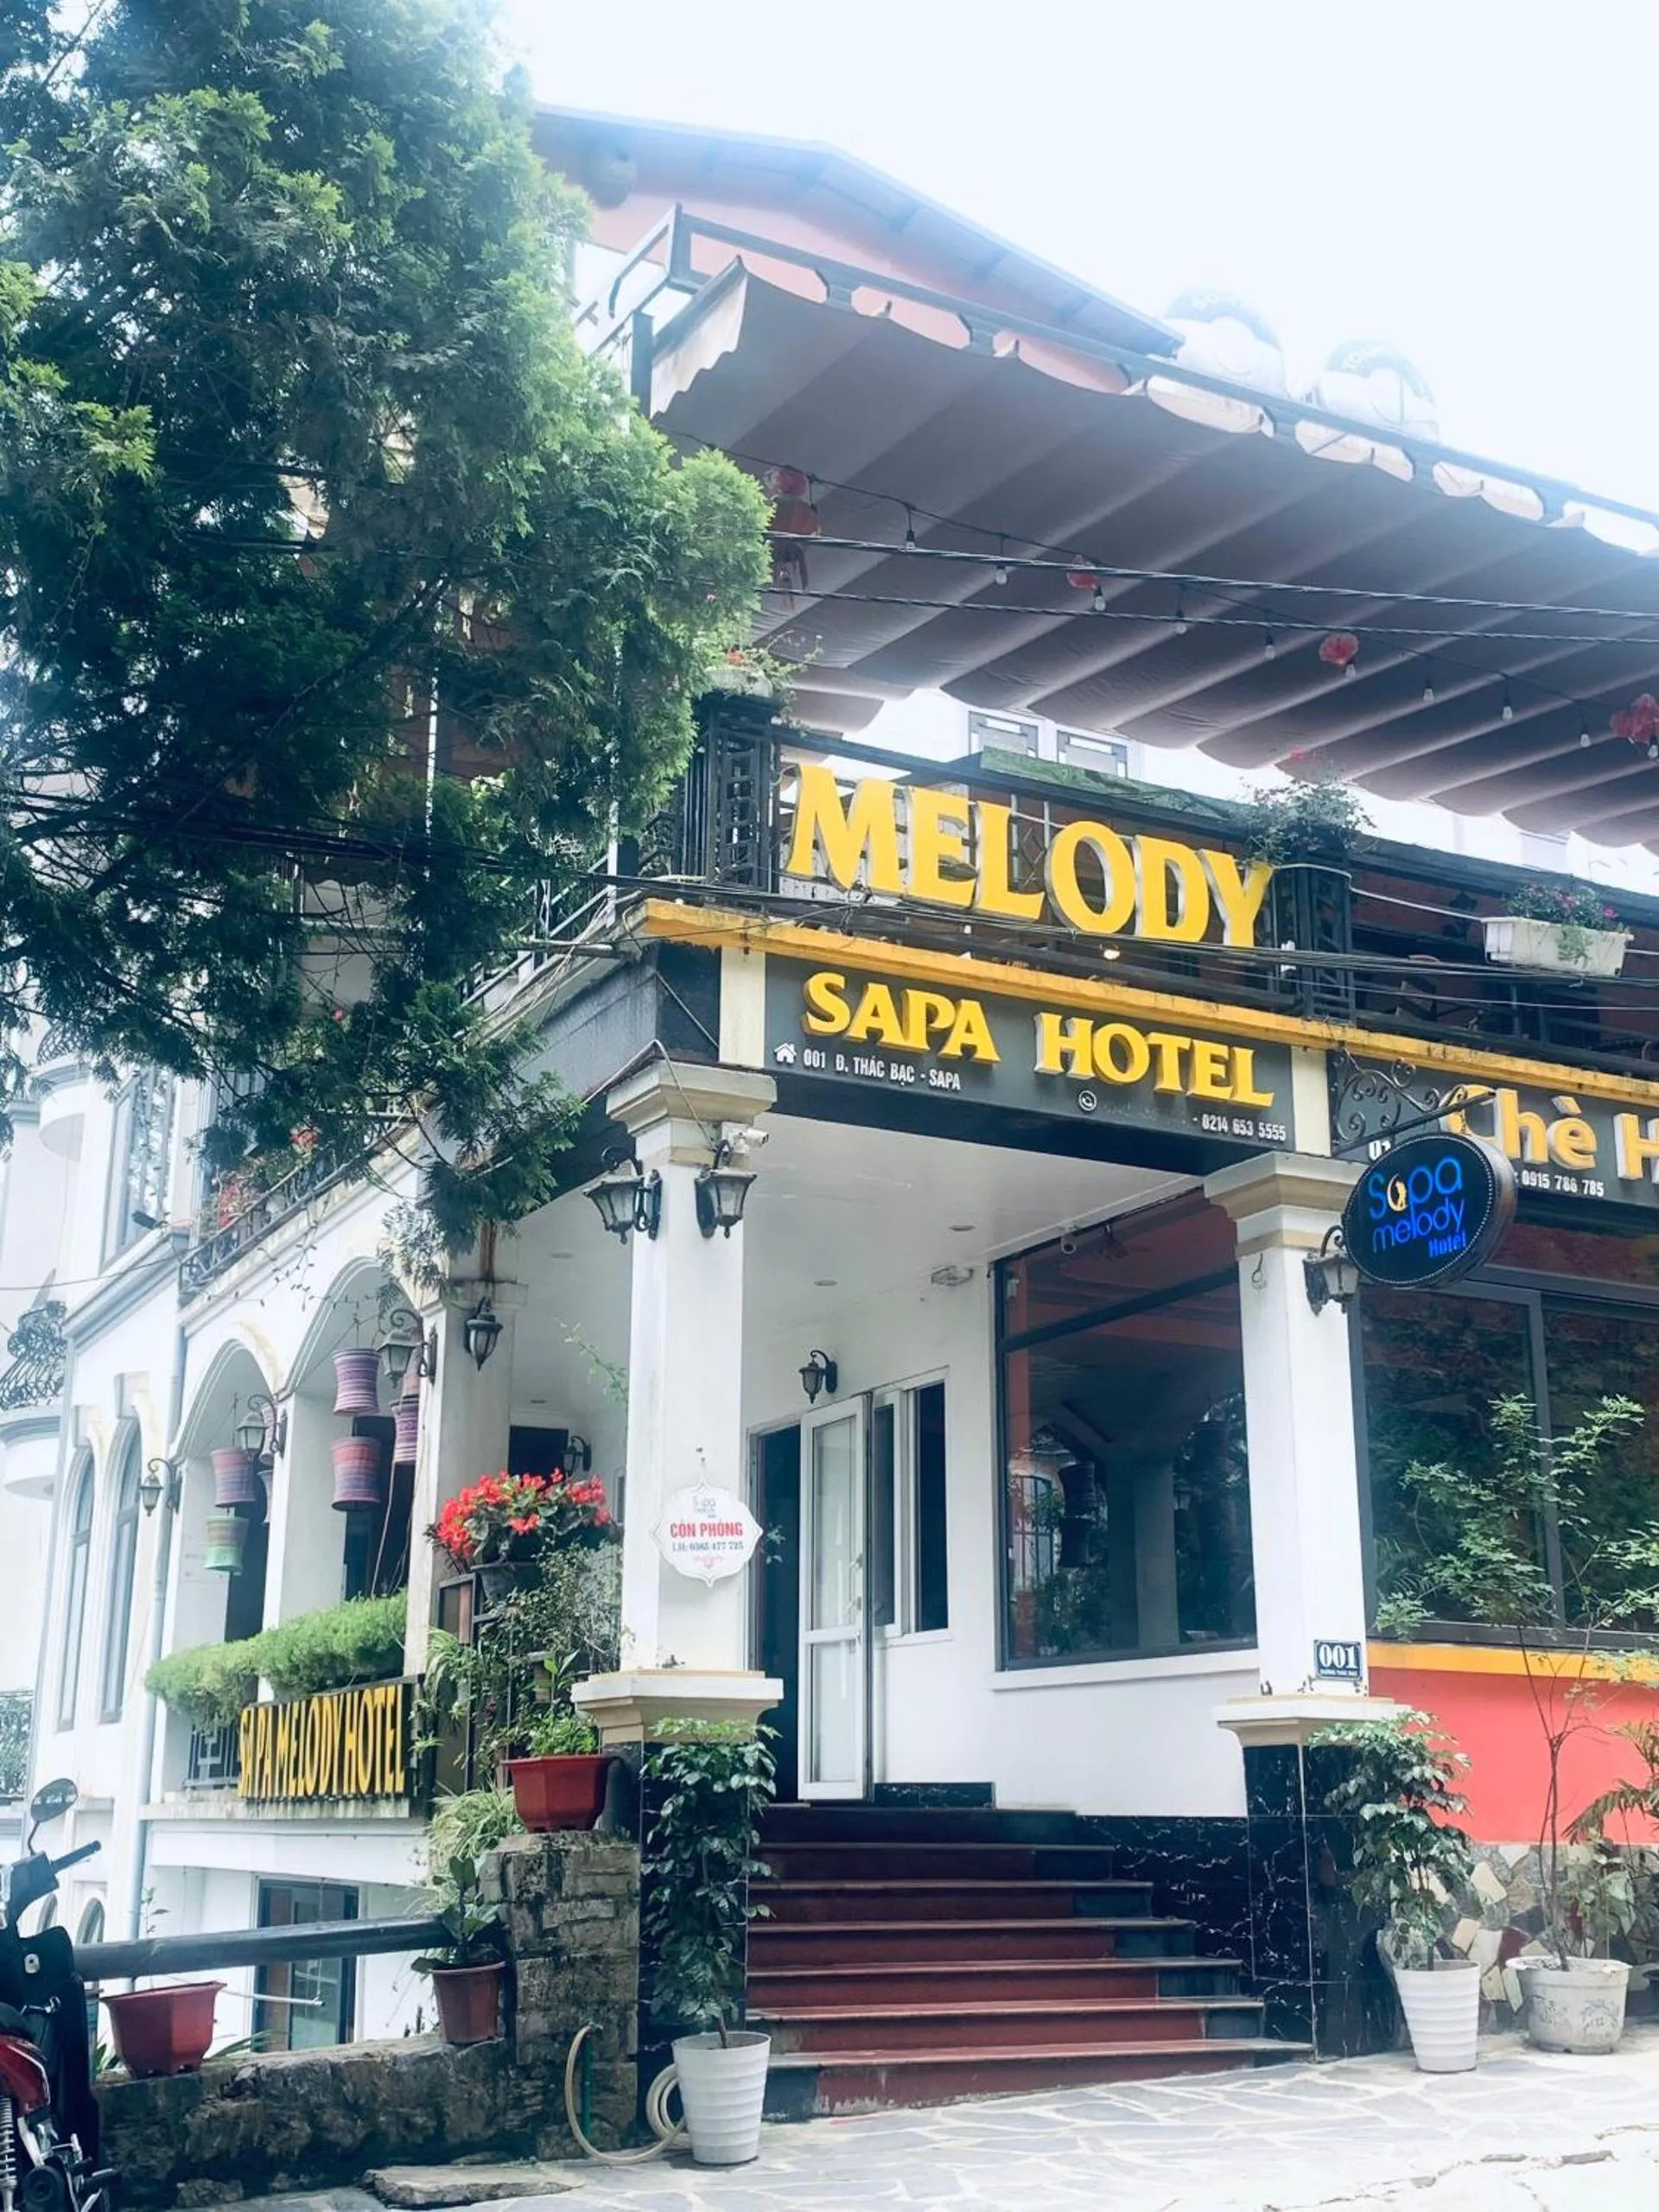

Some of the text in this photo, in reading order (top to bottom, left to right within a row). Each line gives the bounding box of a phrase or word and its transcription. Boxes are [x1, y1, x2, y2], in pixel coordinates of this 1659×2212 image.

[785, 763, 1274, 947] MELODY
[802, 971, 1274, 1108] SAPA HOTEL
[804, 1049, 826, 1069] 001
[853, 1055, 885, 1077] THÁC
[890, 1063, 915, 1086] BẠC
[928, 1068, 962, 1091] SAPA
[1202, 1114, 1229, 1134] 0214
[1232, 1118, 1254, 1137] 653
[1258, 1122, 1287, 1141] 5555
[1522, 1169, 1550, 1190] 0915
[1581, 1179, 1605, 1198] 785
[1372, 1197, 1465, 1254] melody
[1428, 1230, 1466, 1257] Hotel
[1319, 1644, 1357, 1669] 001
[275, 1694, 344, 1797] MELODY
[344, 1683, 404, 1795] HOTEL
